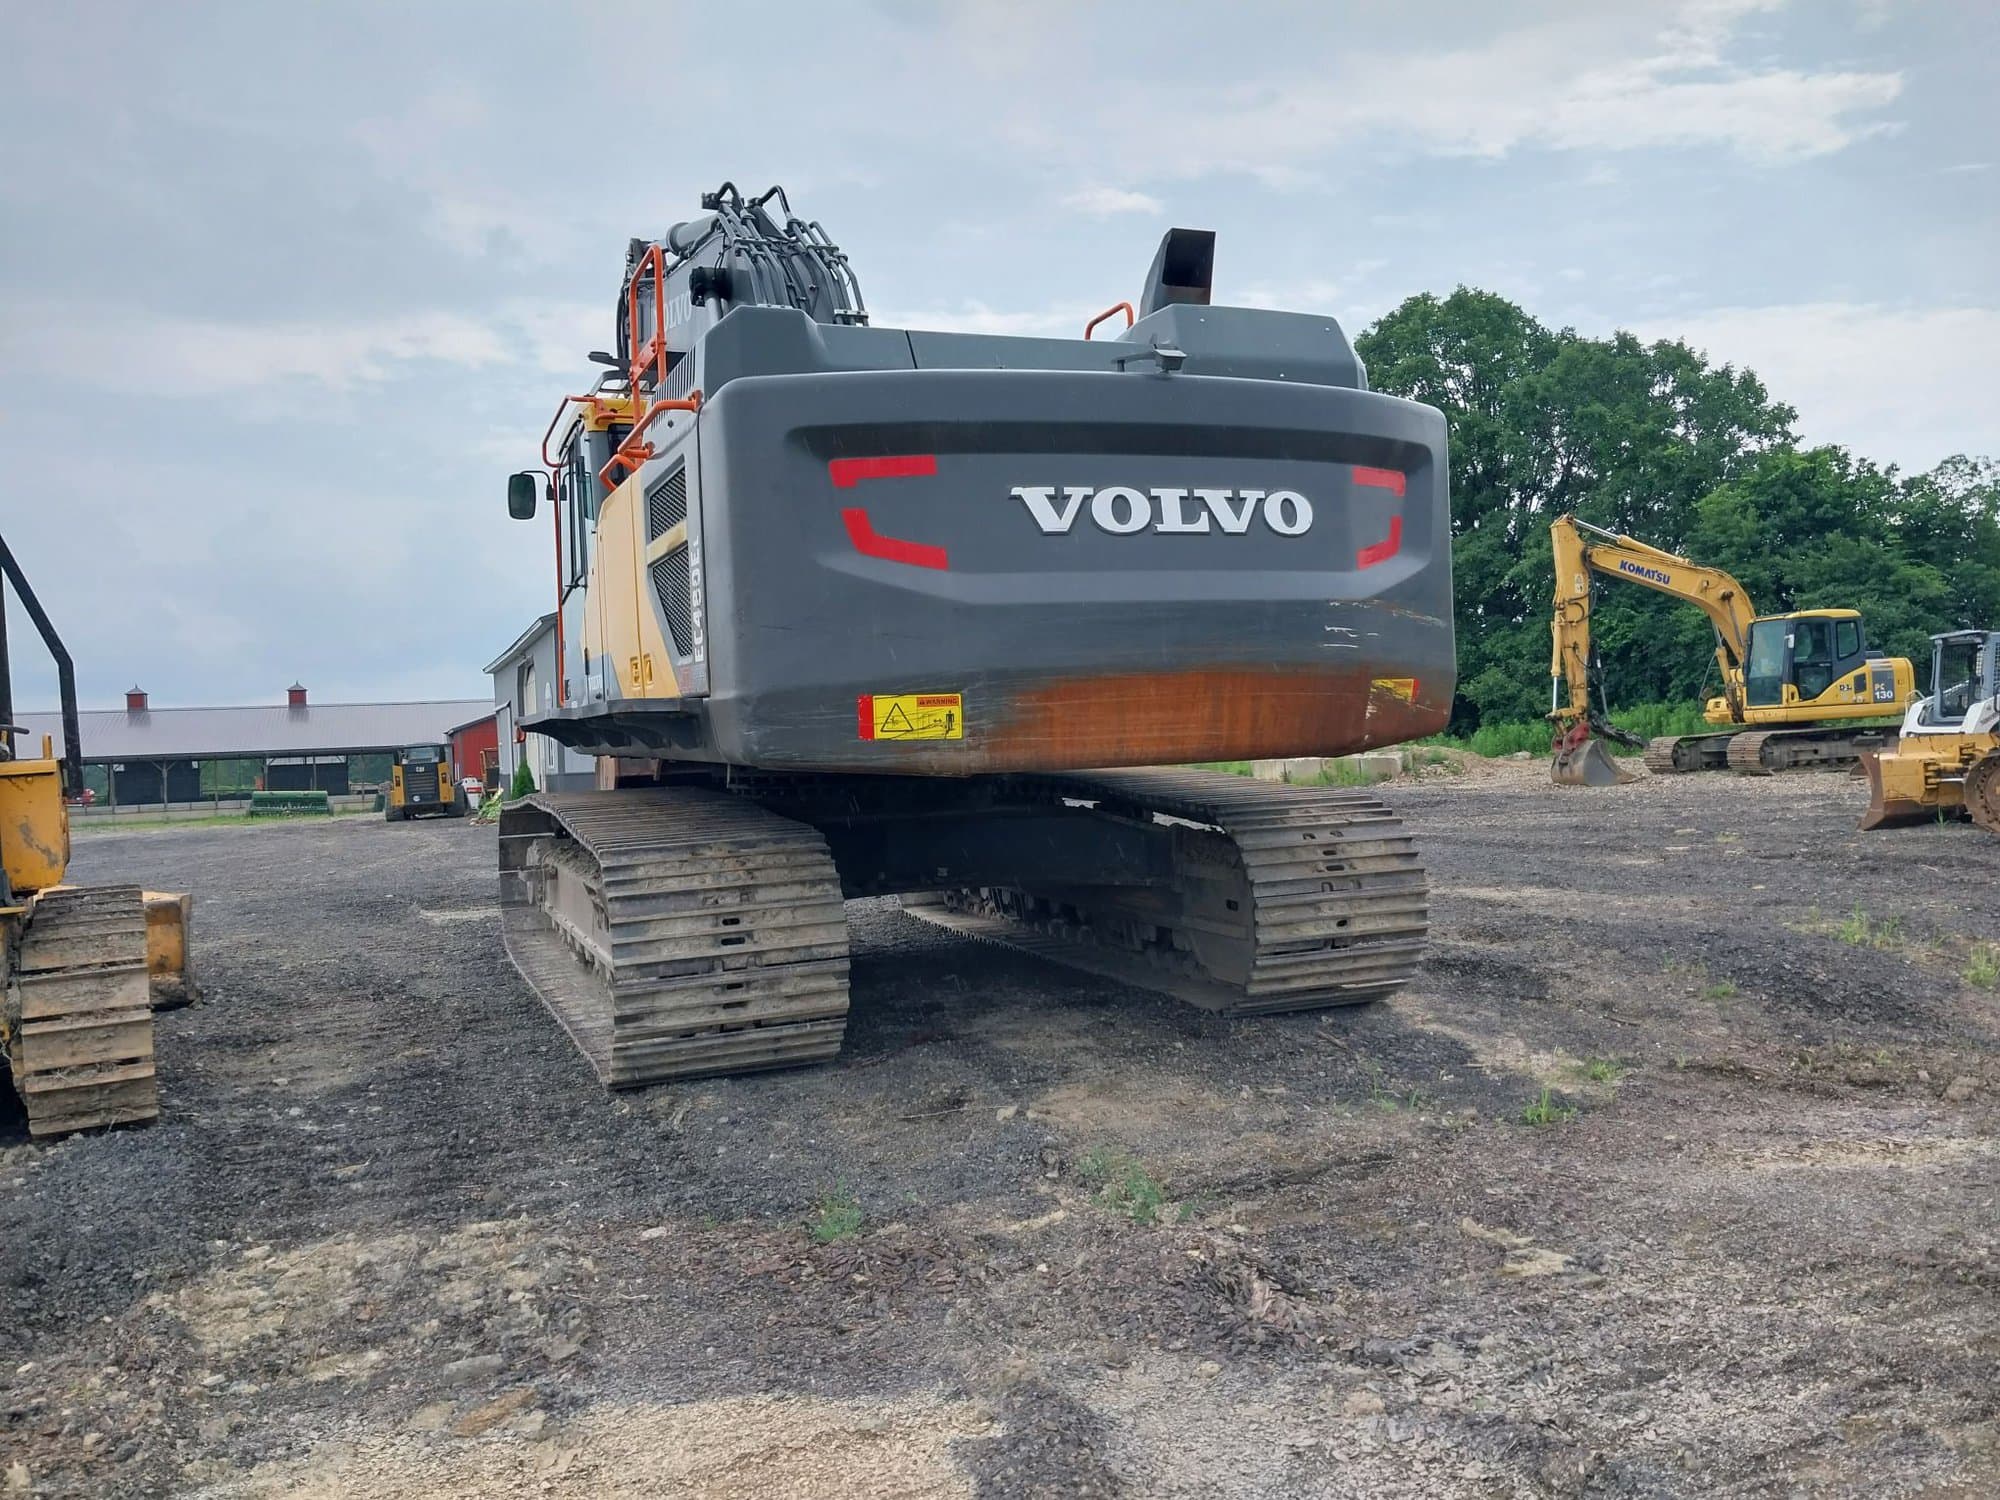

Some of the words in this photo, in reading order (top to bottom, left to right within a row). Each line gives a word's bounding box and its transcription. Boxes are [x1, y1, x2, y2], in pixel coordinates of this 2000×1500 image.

[1009, 486, 1313, 535] VOLVO
[1619, 560, 1671, 585] KOMATSU
[1874, 691, 1893, 700] 130
